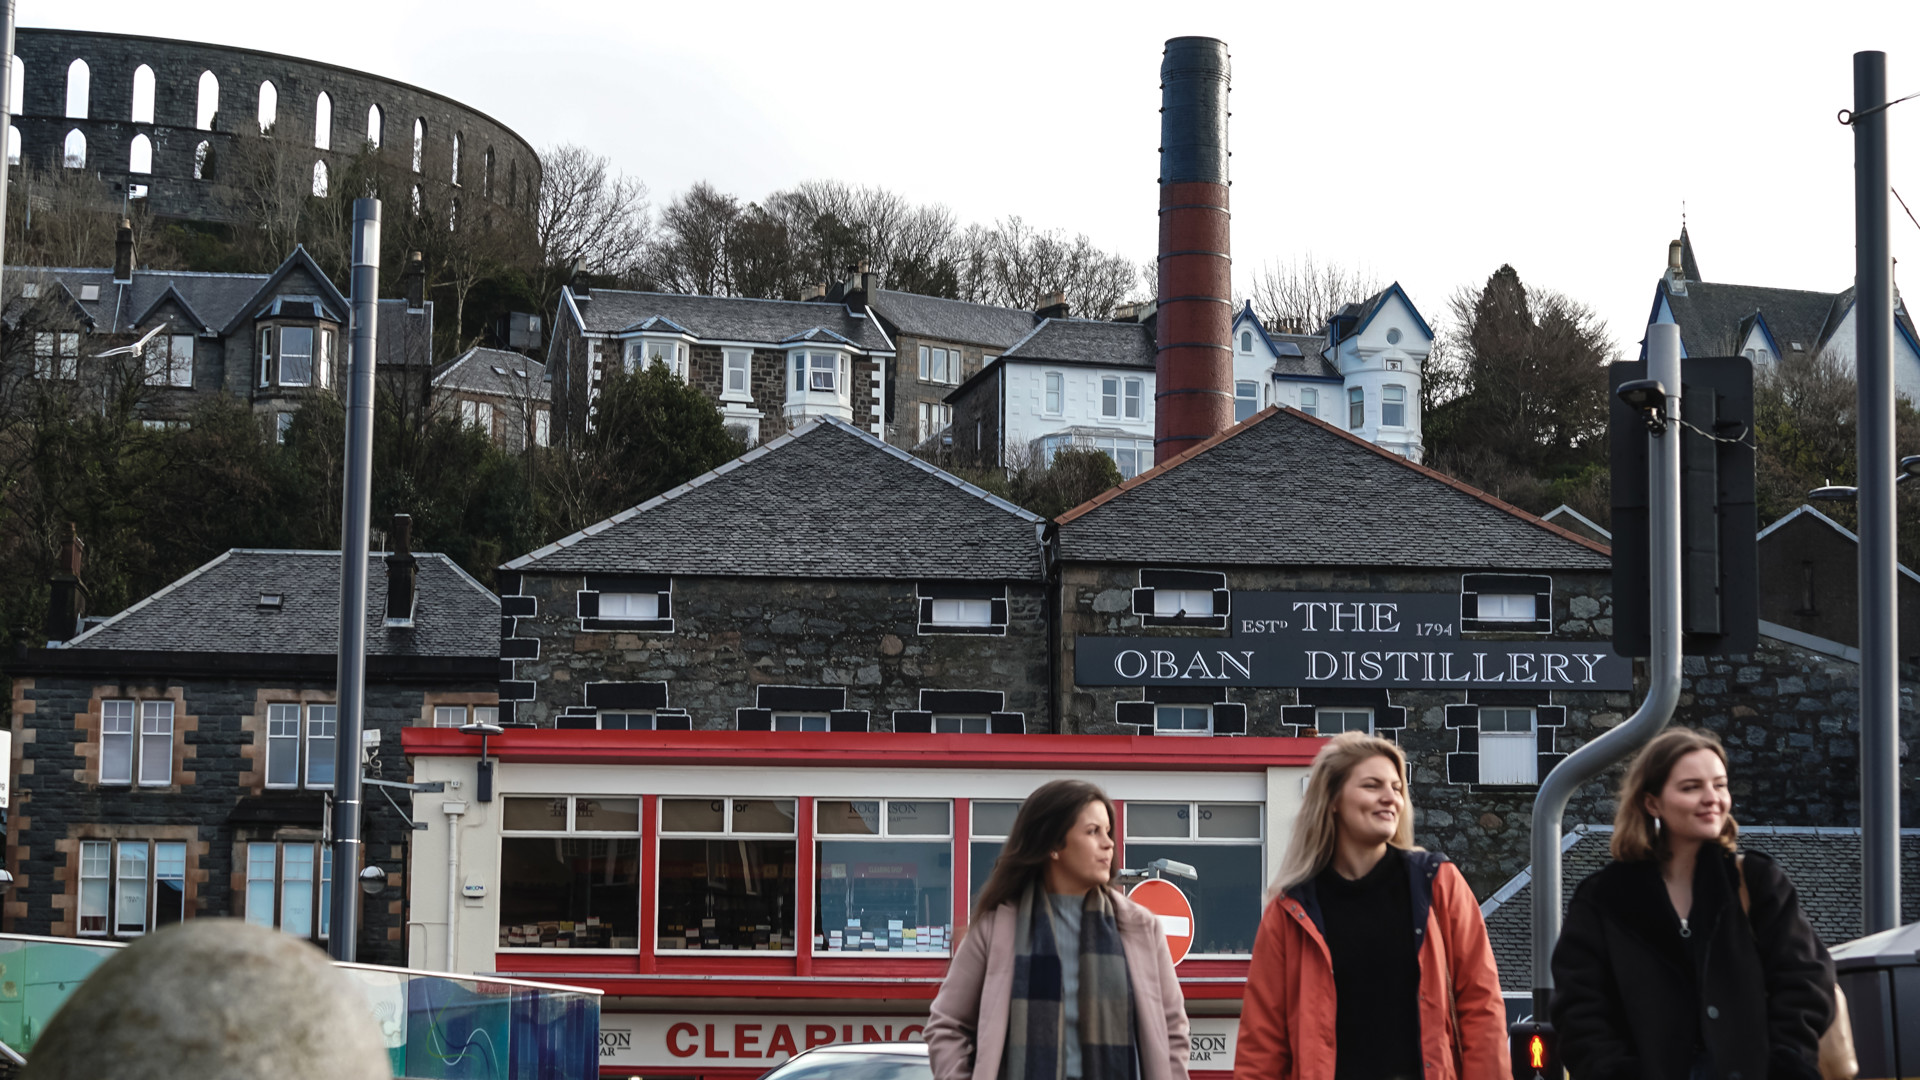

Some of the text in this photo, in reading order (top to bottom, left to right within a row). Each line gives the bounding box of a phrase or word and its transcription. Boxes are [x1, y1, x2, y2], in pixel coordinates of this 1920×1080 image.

[1292, 602, 1401, 633] THE
[1415, 623, 1453, 637] 1794
[1113, 649, 1607, 684] OBAN DISTILLERY
[665, 1022, 925, 1058] CLEARIN
